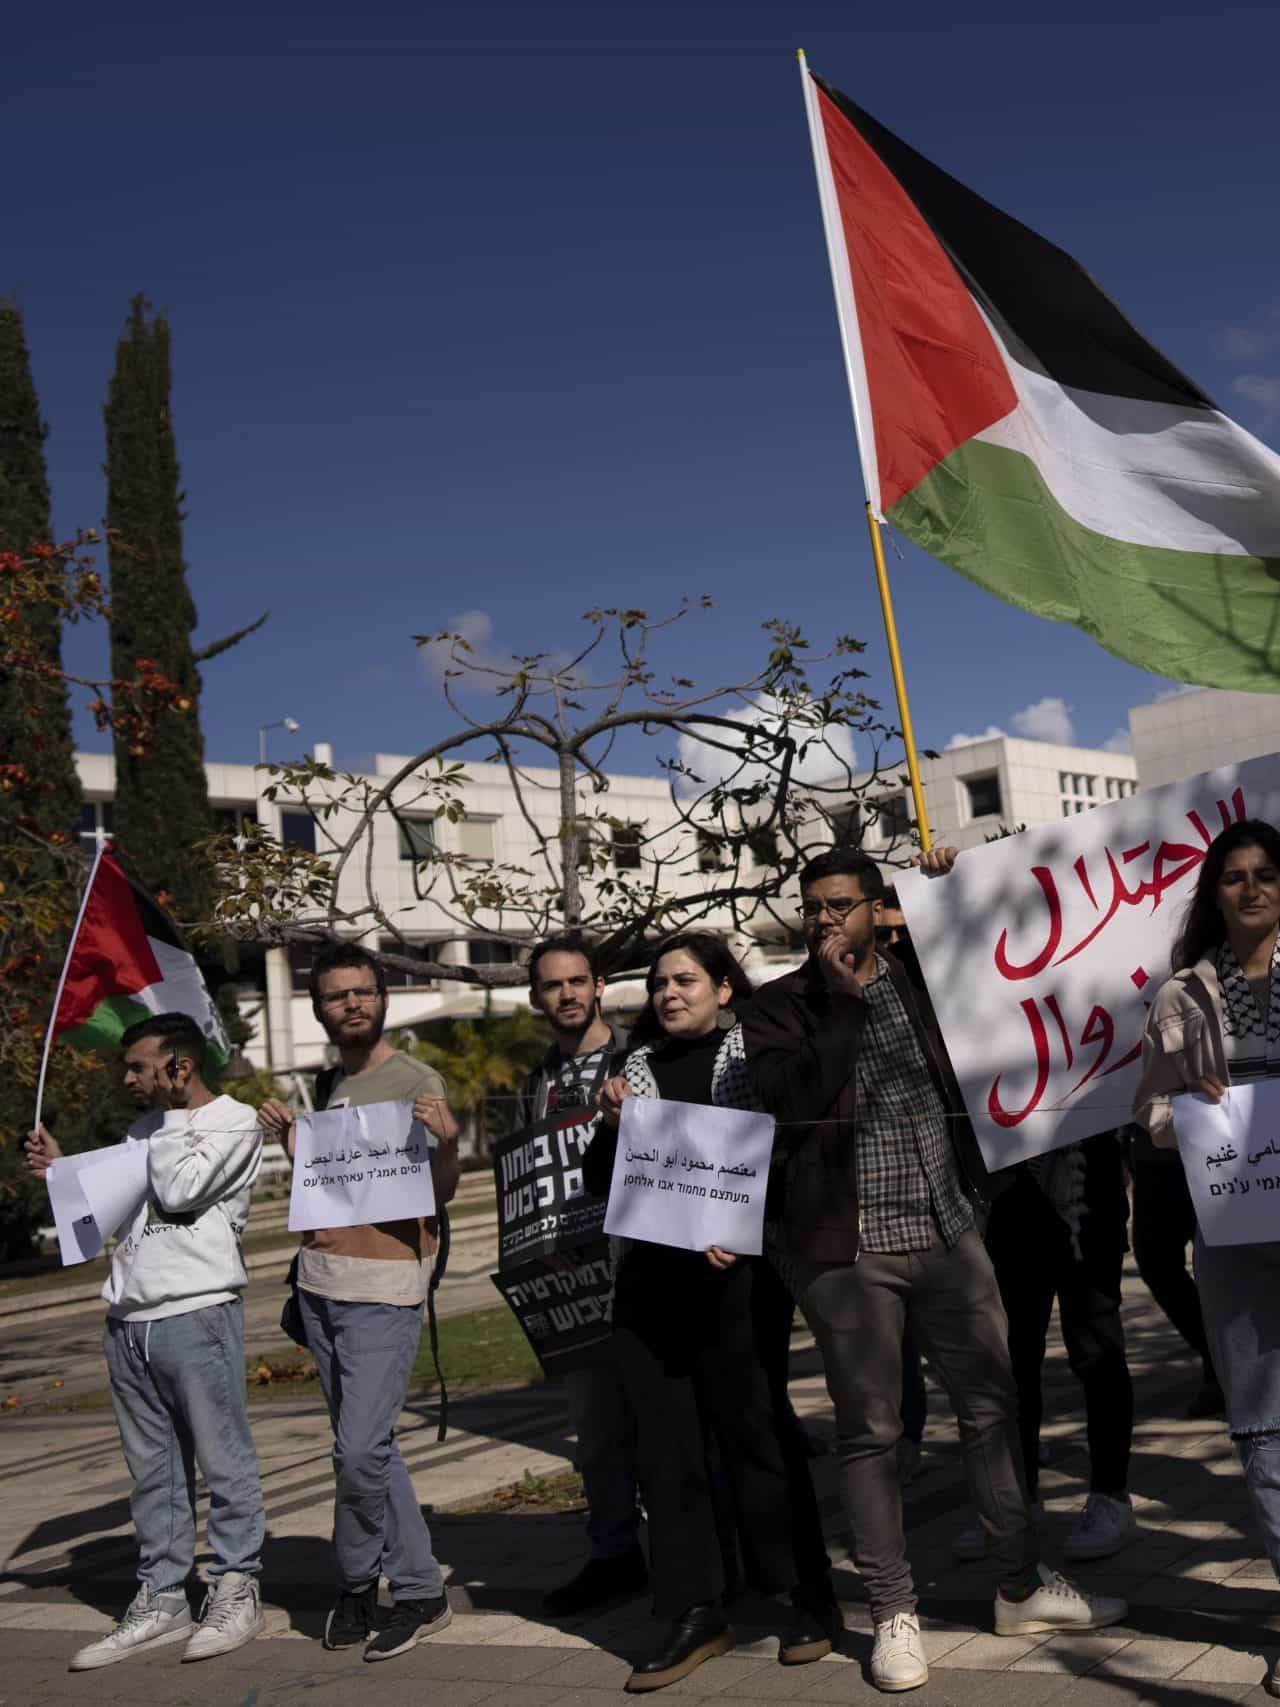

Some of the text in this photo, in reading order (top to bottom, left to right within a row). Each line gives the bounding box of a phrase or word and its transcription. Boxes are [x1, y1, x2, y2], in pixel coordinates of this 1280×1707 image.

[557, 1119, 599, 1168] אין
[625, 1148, 659, 1162] الحسن
[1206, 1144, 1239, 1171] غنيم
[400, 1165, 421, 1175] וסים
[681, 1156, 714, 1172] محمود
[337, 1172, 363, 1186] עארף
[624, 1173, 750, 1204] מעתצם מחמוד אבו אלחסן
